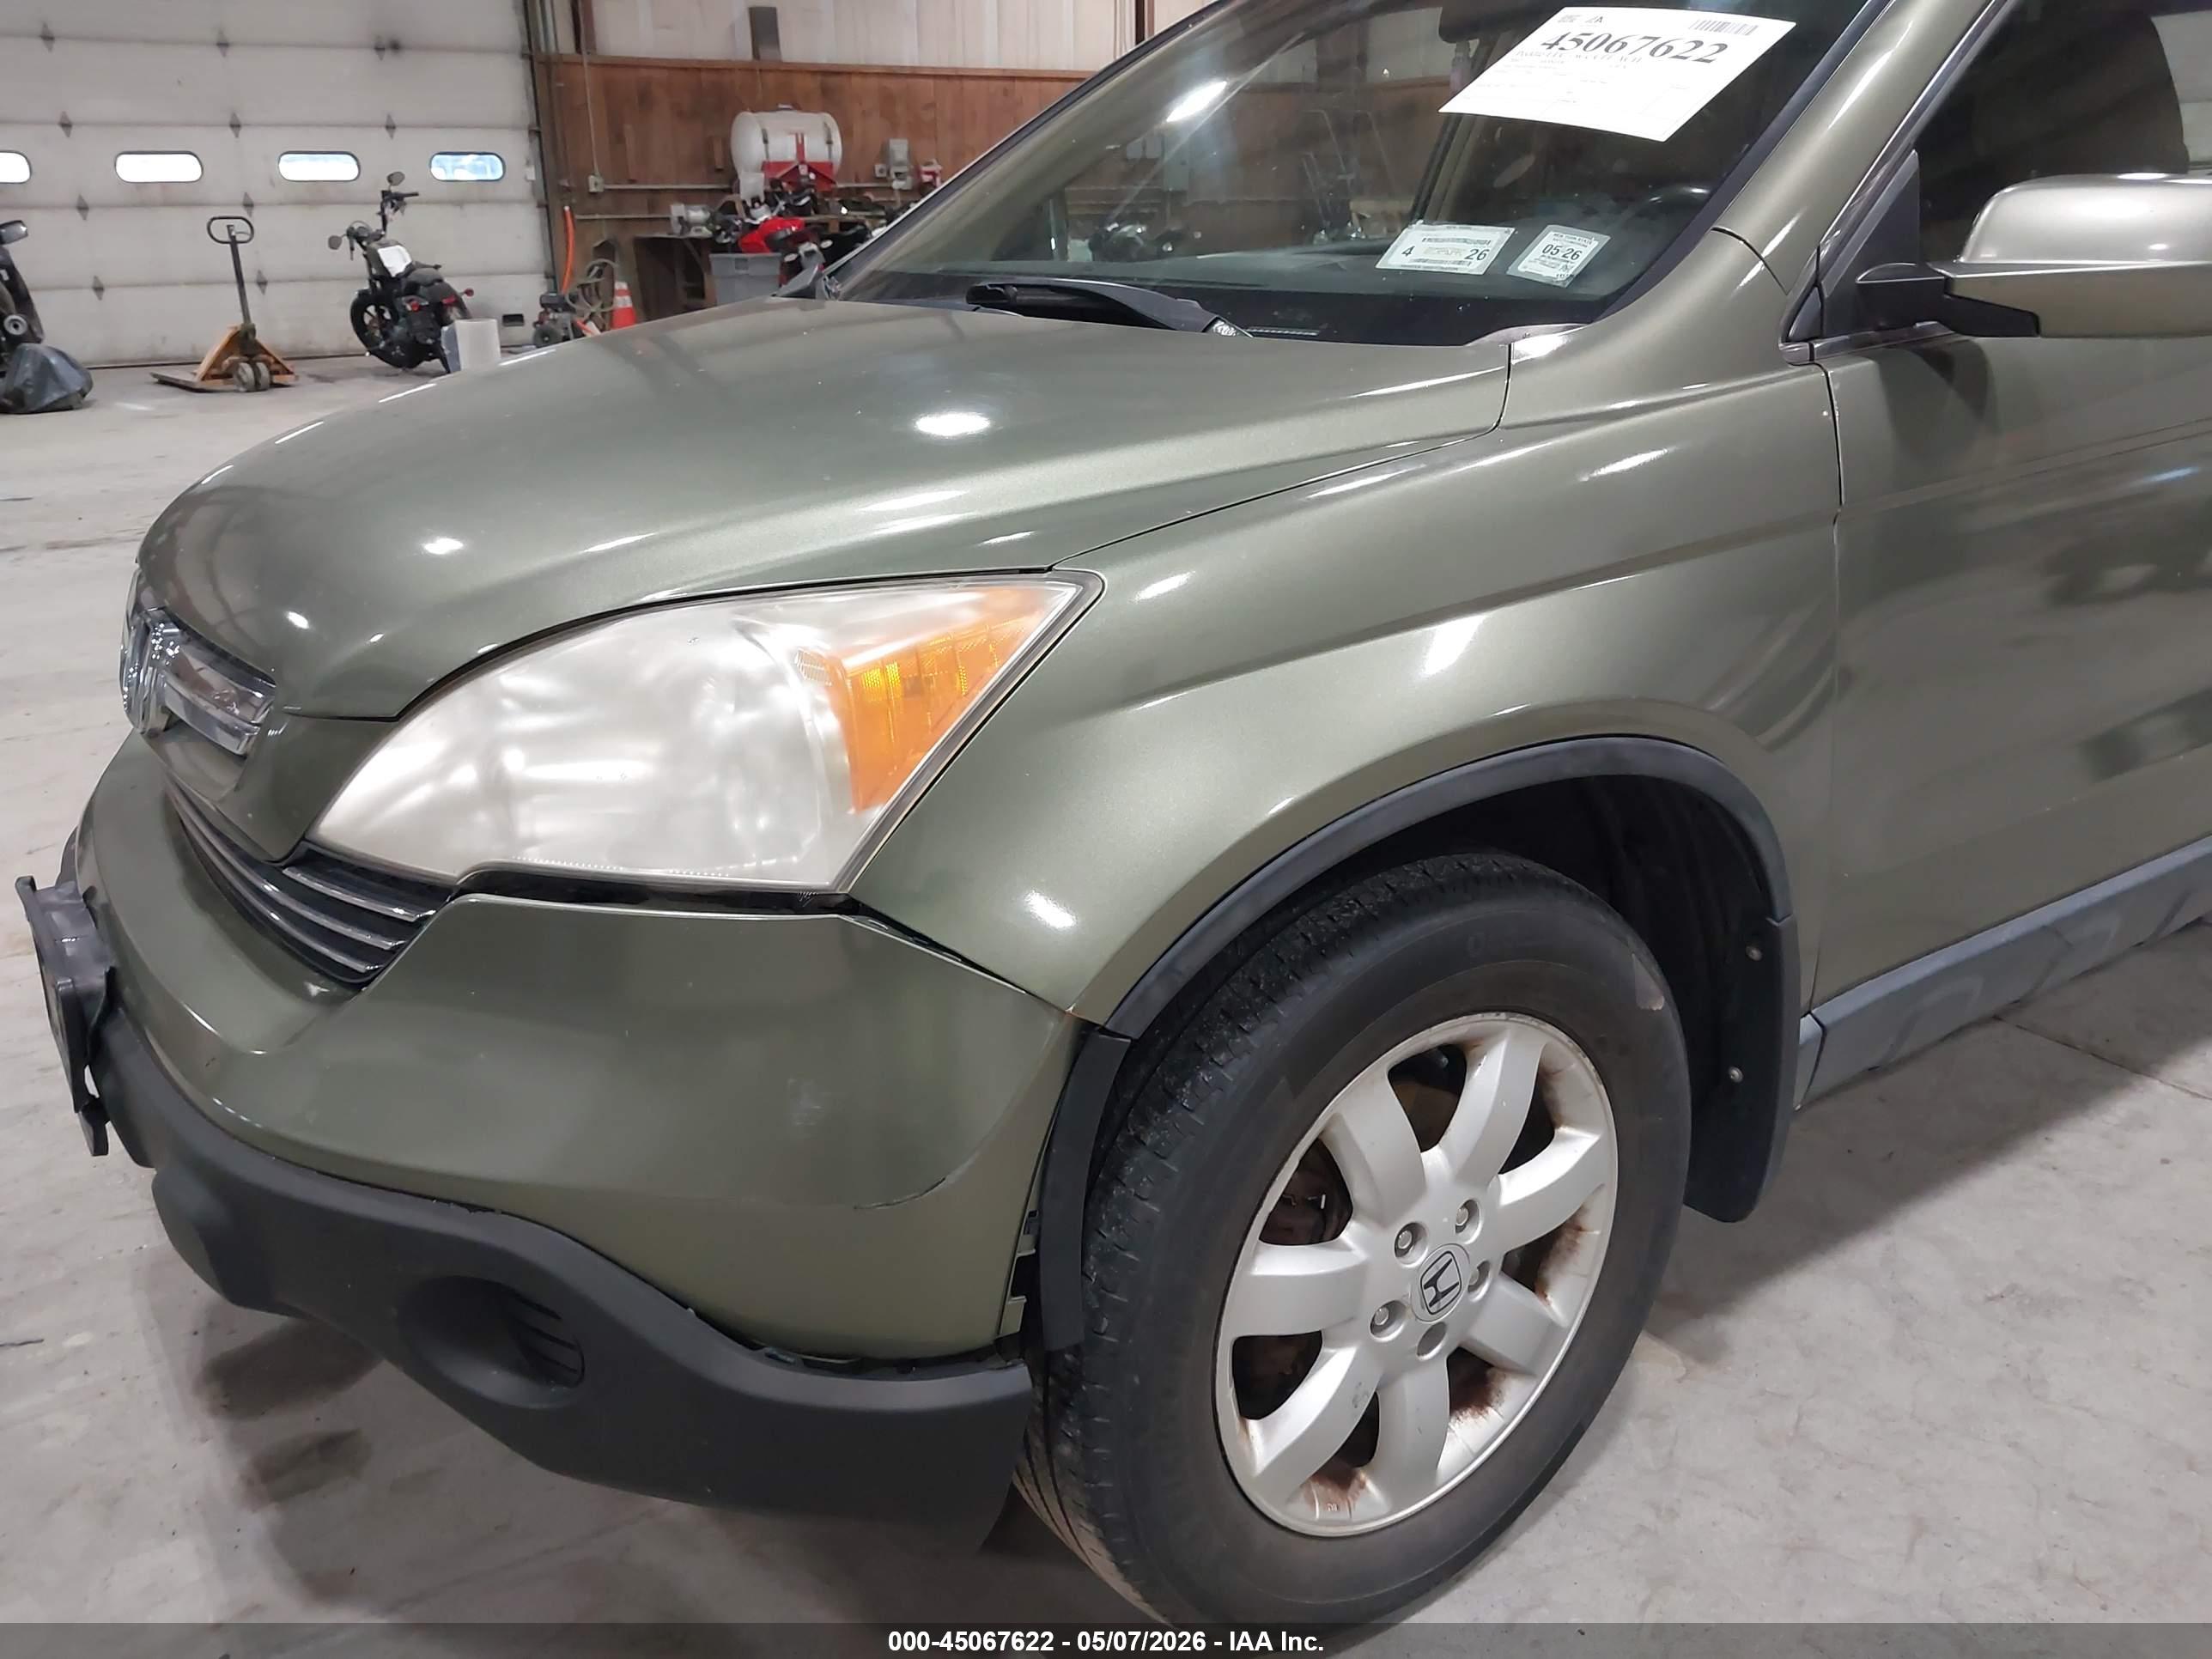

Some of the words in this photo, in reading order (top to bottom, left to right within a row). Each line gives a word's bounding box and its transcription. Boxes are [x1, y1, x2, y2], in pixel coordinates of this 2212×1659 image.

[1540, 31, 1729, 64] 45067622
[1401, 246, 1415, 258] 4
[1464, 247, 1490, 261] 26
[1542, 243, 1561, 256] 05
[1562, 246, 1583, 261] 26
